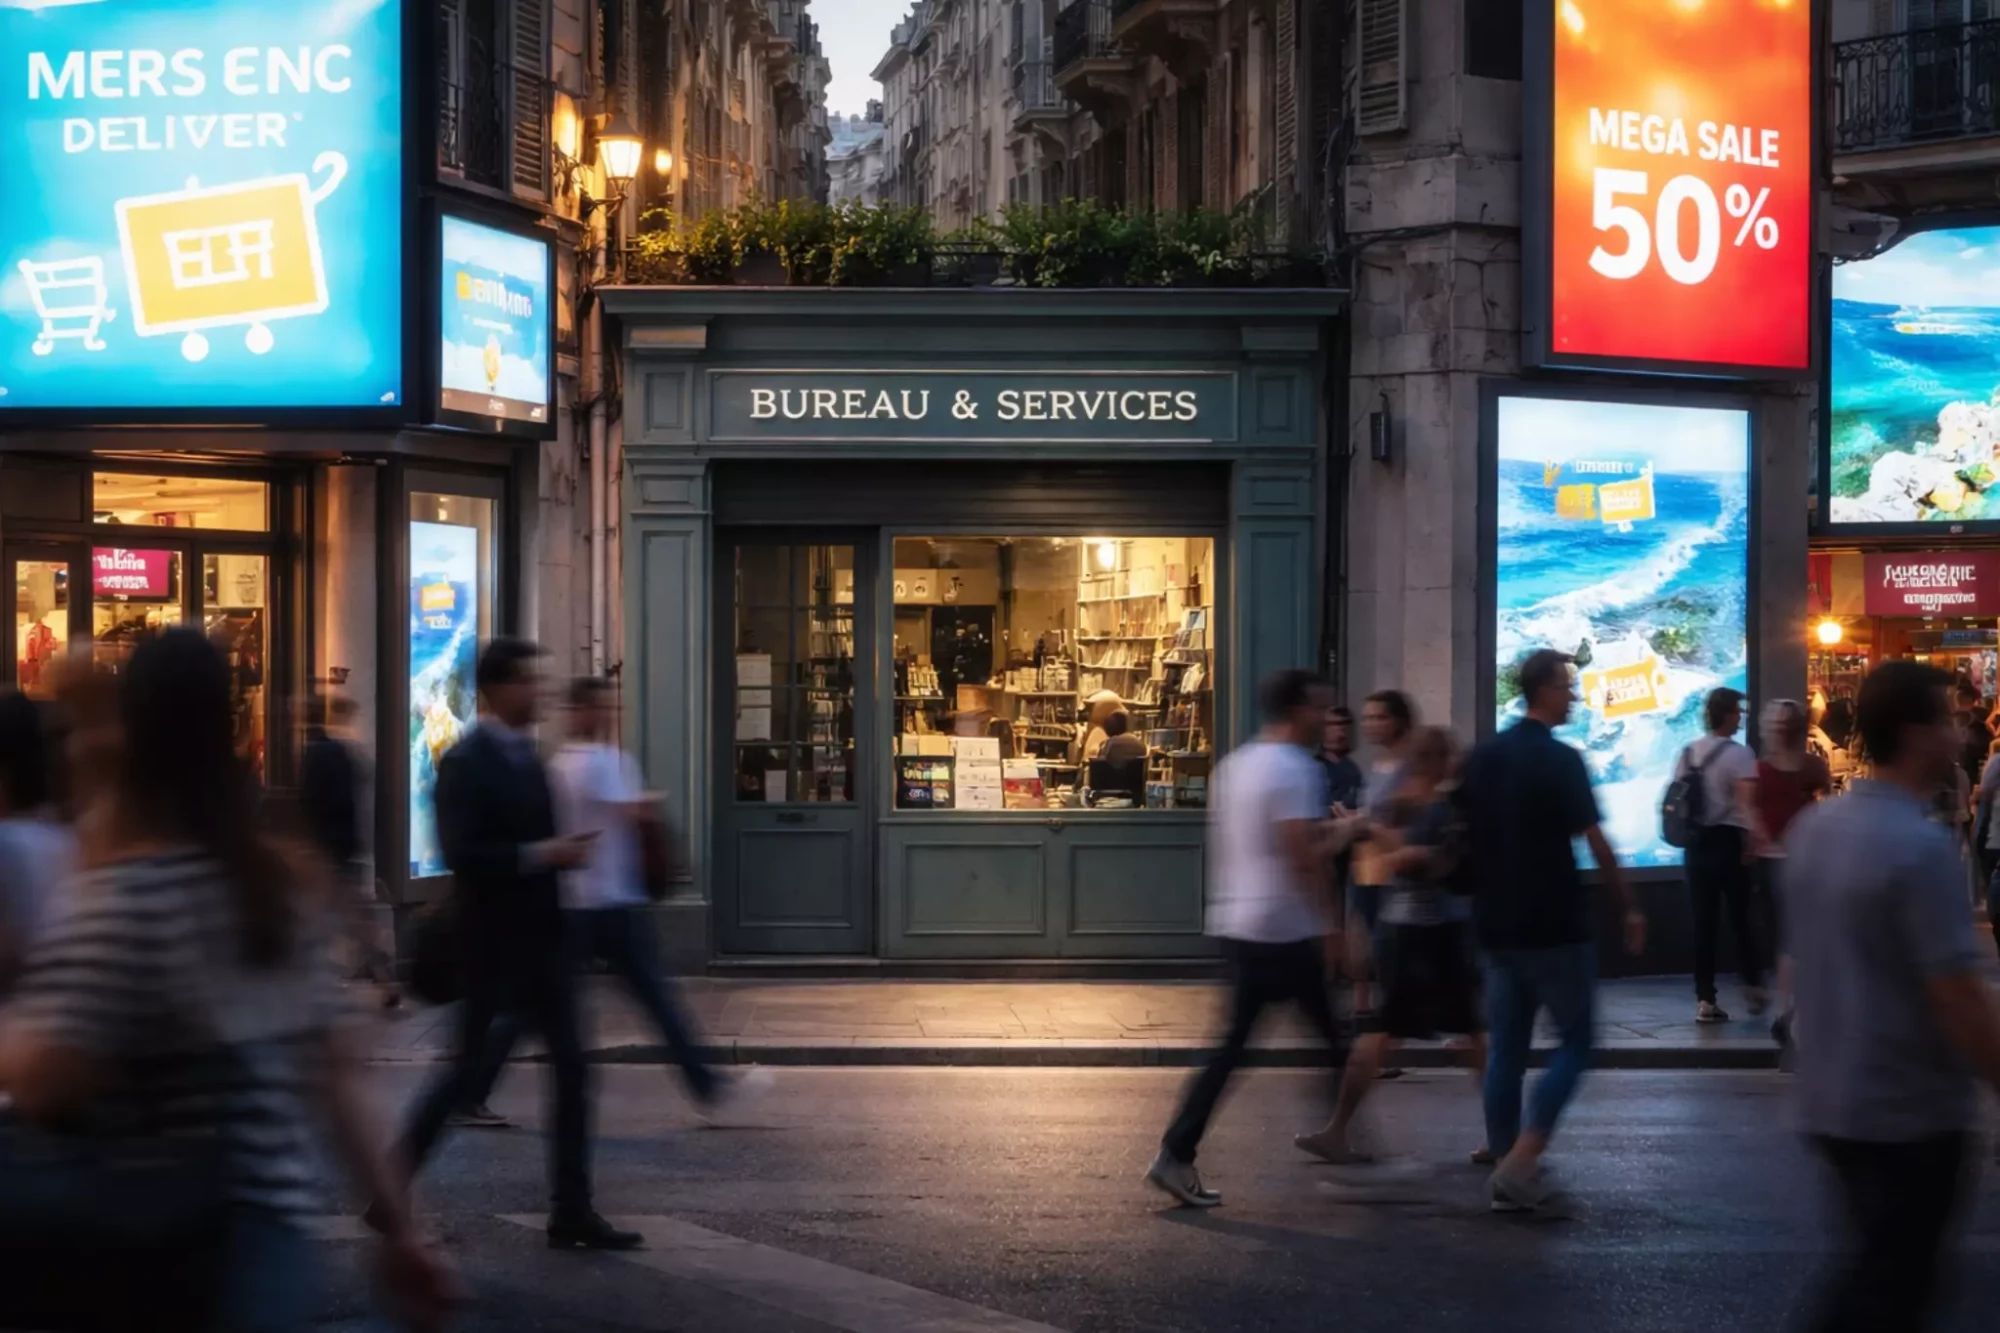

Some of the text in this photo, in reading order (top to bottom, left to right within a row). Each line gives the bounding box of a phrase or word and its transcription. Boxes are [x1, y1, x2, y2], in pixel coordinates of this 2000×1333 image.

[28, 45, 352, 99] MERS ENC
[63, 112, 288, 153] DELIVER
[1589, 107, 1780, 168] MEGA SALE
[1588, 167, 1779, 285] 50%
[750, 388, 1198, 421] BUREAU & SERVICES
